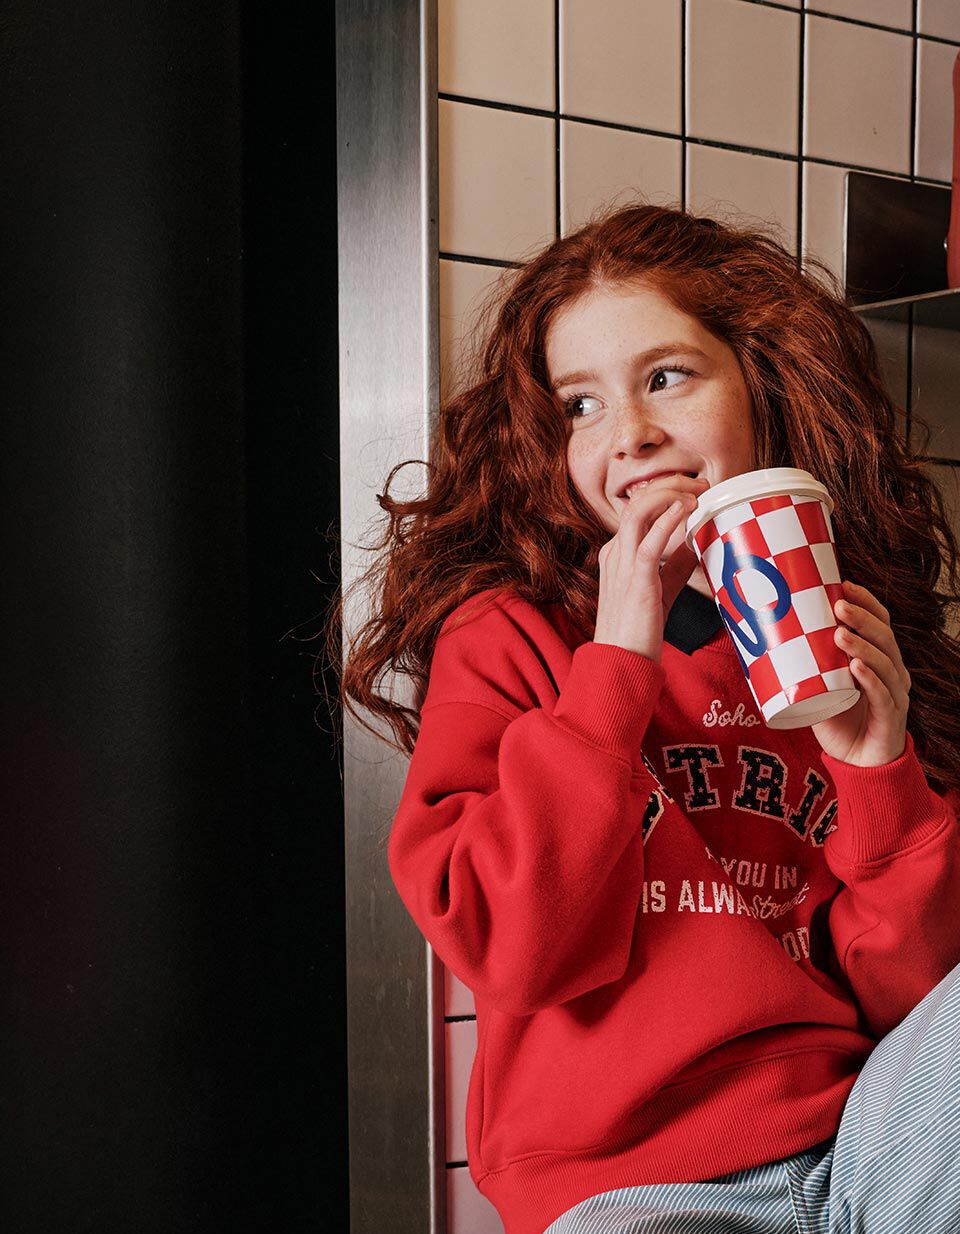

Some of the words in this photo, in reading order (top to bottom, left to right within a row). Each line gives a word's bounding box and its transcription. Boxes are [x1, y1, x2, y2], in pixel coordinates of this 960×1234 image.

[702, 699, 761, 728] Soho
[720, 857, 767, 888] YOU
[775, 865, 798, 890] IN
[642, 880, 666, 914] IS
